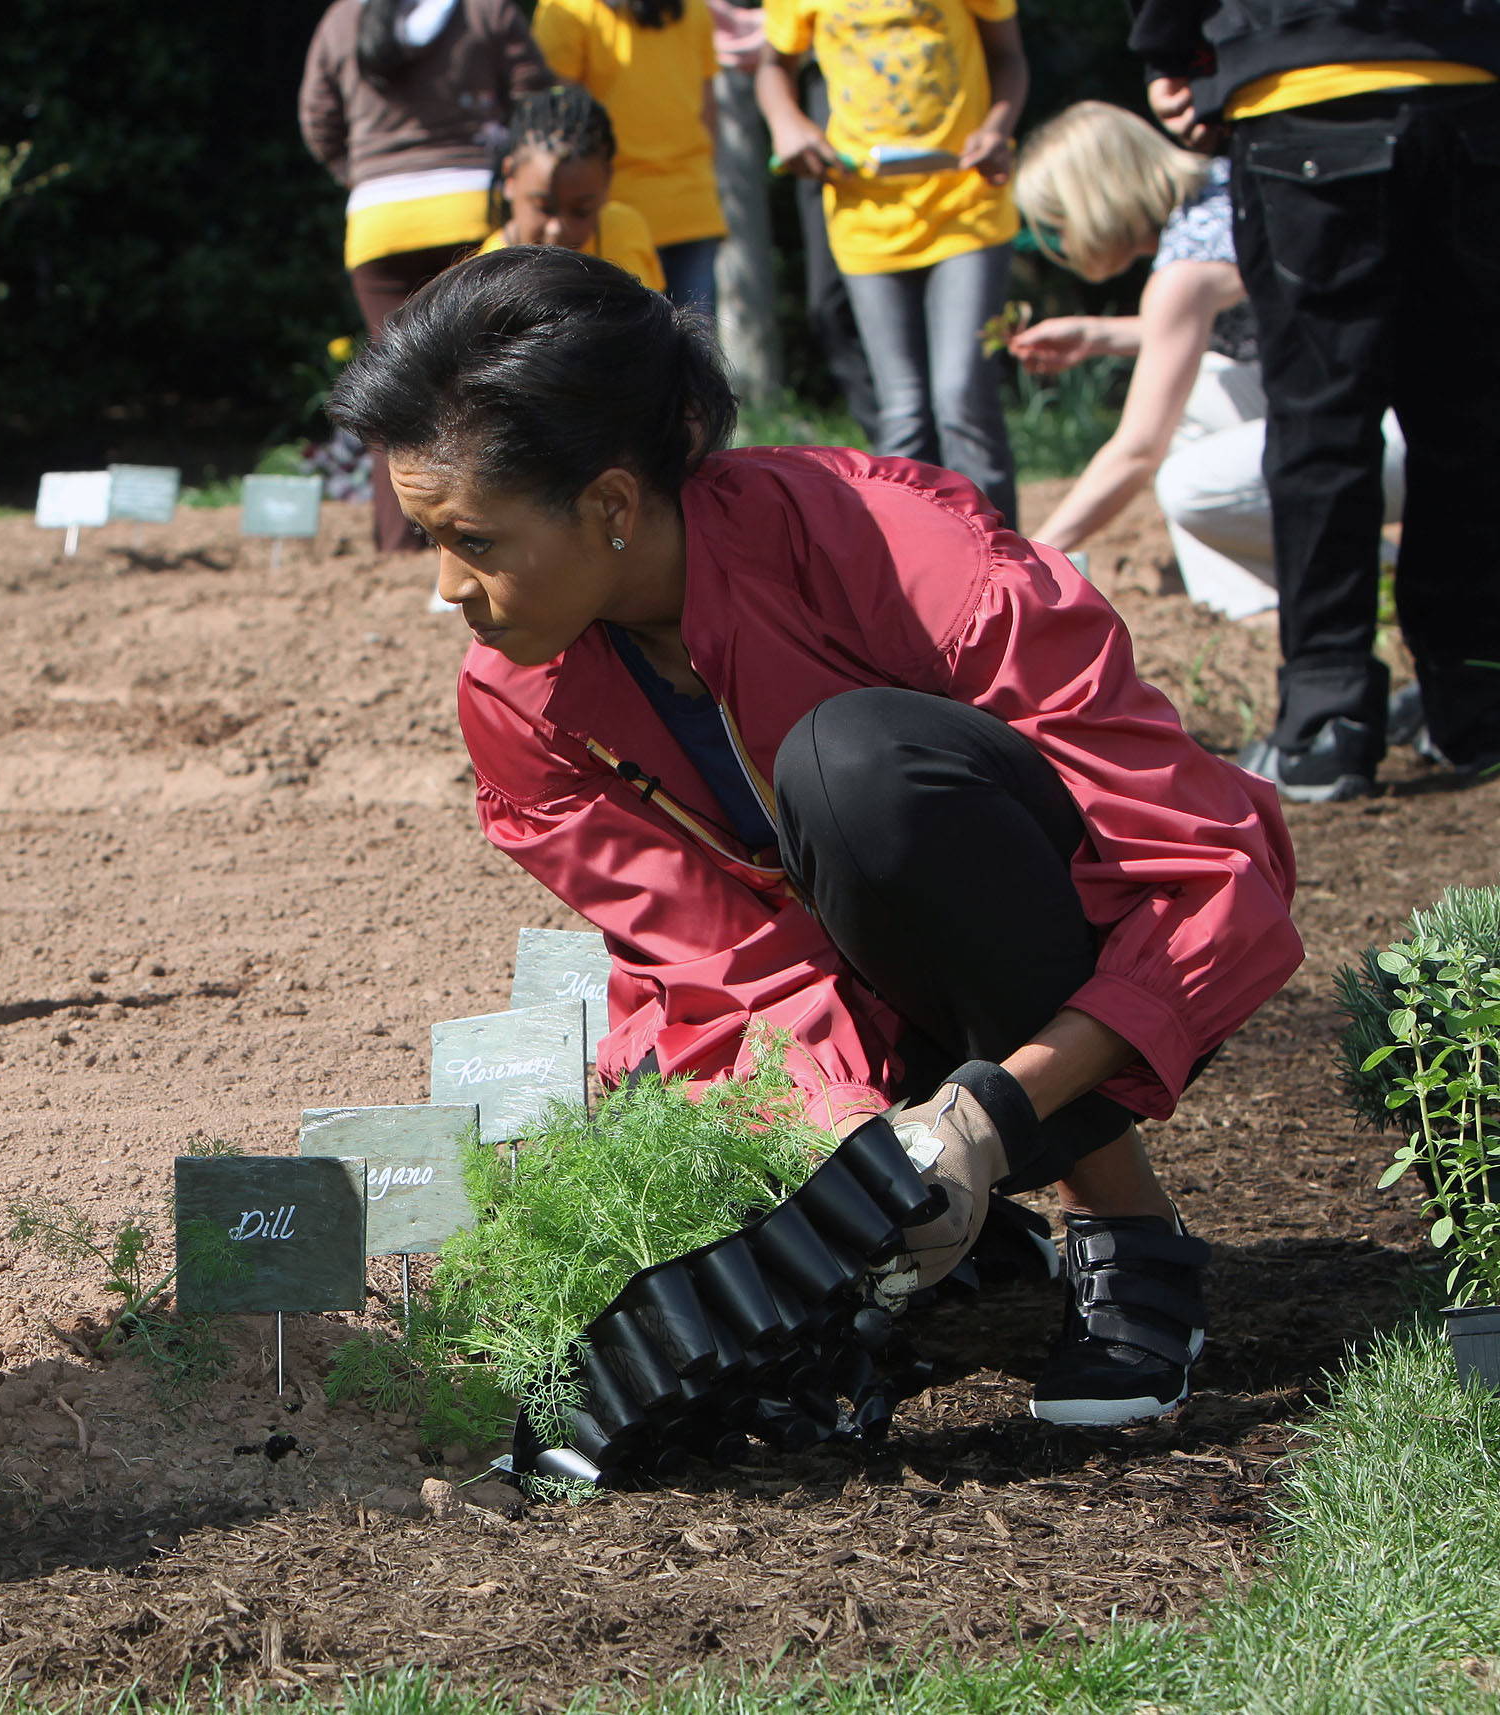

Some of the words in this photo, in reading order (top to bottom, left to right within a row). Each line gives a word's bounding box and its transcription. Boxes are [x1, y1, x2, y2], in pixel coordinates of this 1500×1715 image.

[445, 1055, 557, 1087] Rosemary
[366, 1166, 434, 1201] egano
[228, 1204, 296, 1241] Dill
